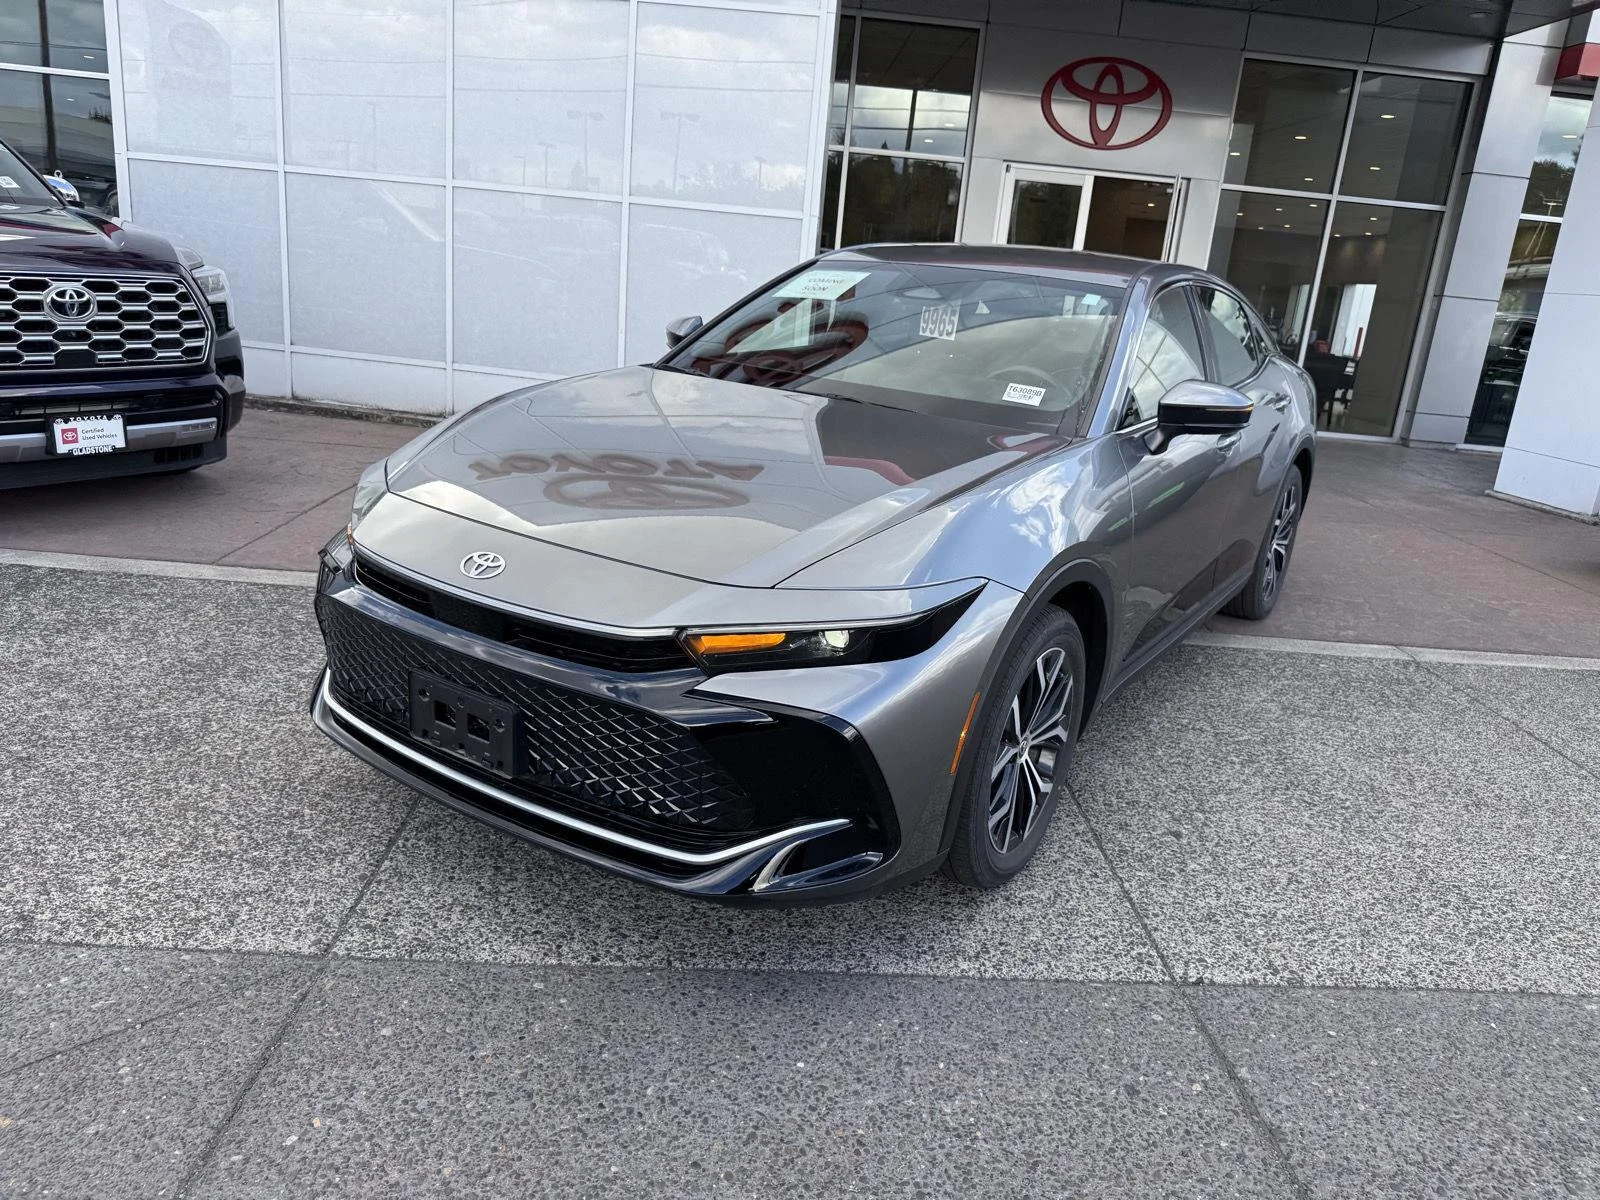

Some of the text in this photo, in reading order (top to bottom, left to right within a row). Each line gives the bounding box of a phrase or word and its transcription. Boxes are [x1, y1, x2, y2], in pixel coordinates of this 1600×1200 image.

[921, 309, 958, 338] 9965
[69, 414, 108, 423] TOYOTA
[81, 427, 105, 435] Certified
[72, 445, 114, 456] GLADSTONE
